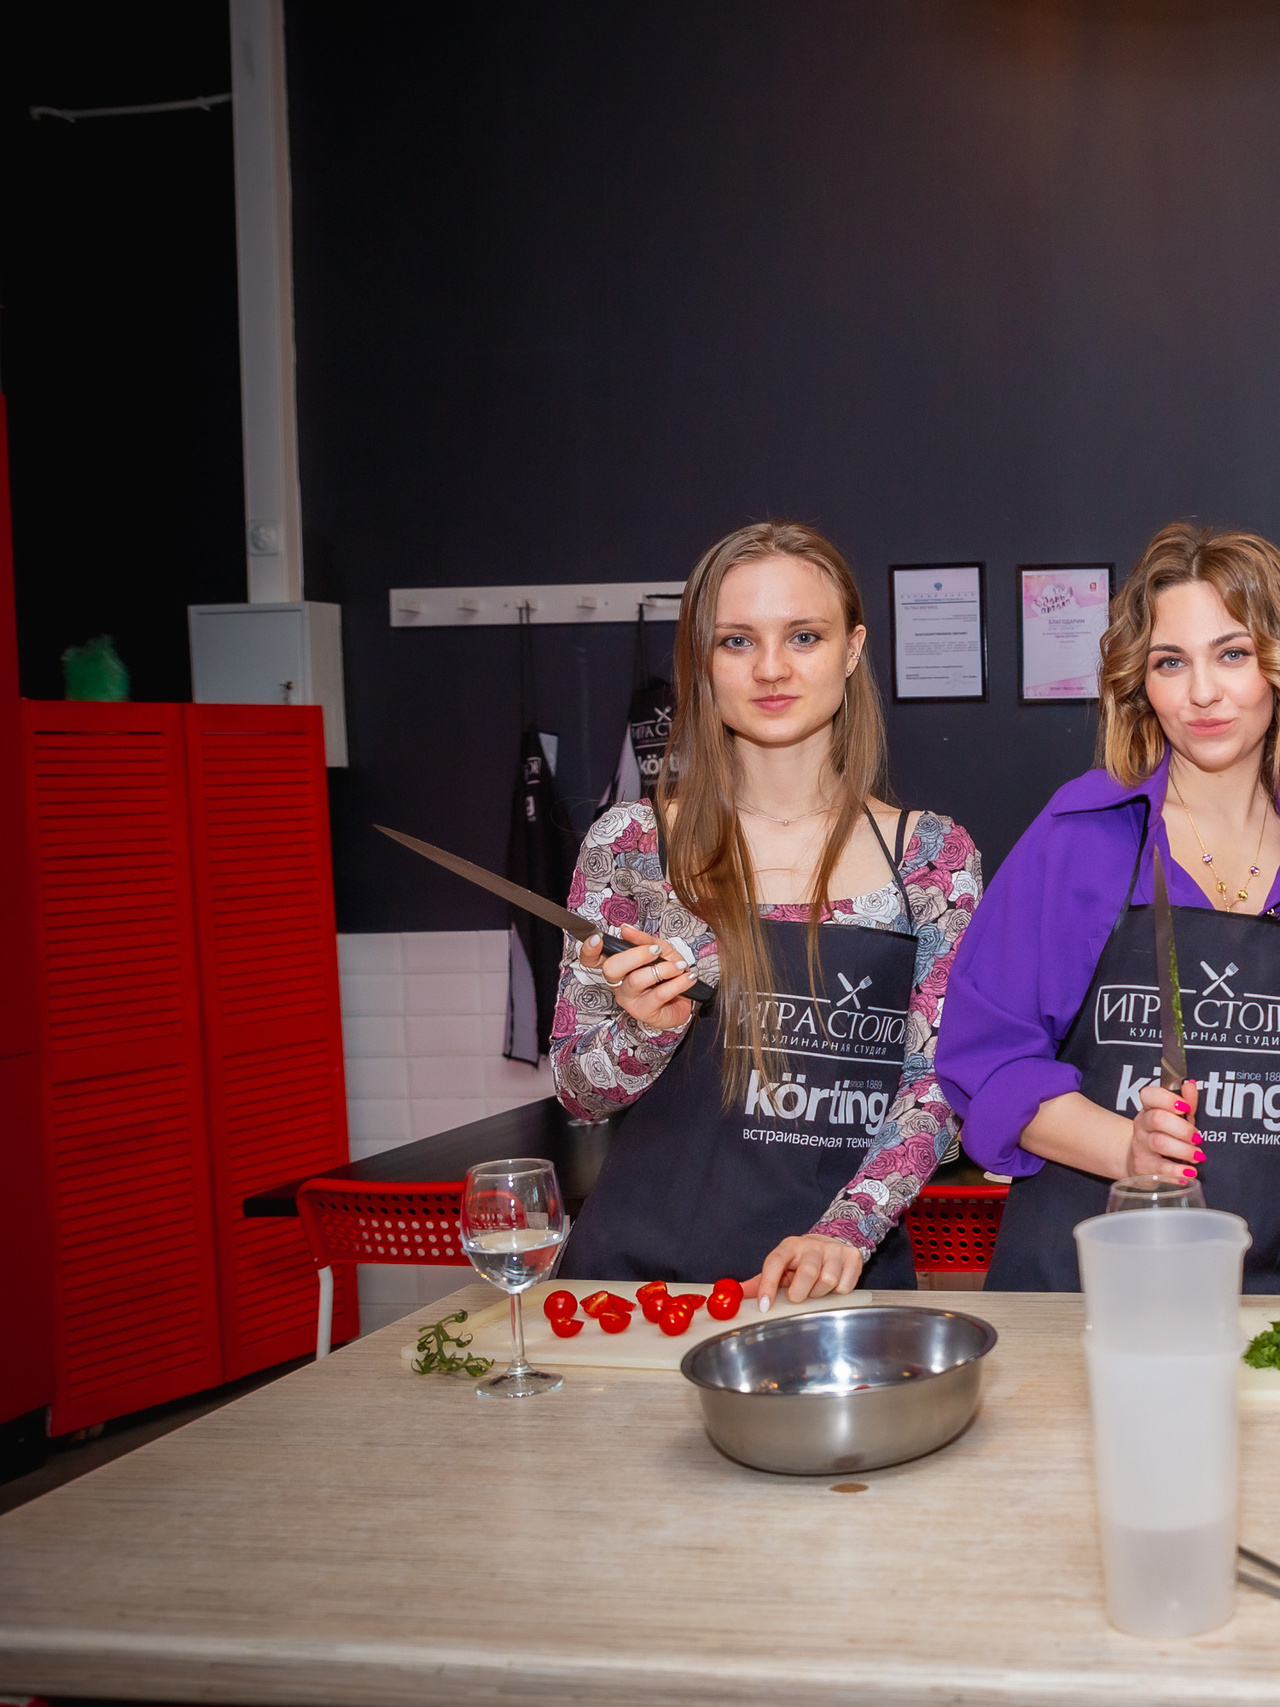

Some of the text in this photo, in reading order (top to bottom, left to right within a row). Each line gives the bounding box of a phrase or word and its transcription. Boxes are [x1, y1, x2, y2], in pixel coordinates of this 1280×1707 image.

[1103, 993, 1184, 1026] ИГР
[762, 1033, 887, 1056] КУЛИНАРНАЯ СТУДИЯ
[1130, 1027, 1227, 1043] КУЛАРНАЯ
[866, 1080, 883, 1090] 1889
[1236, 1071, 1261, 1081] since
[744, 1069, 889, 1136] körting
[743, 1128, 843, 1148] встраиваемая
